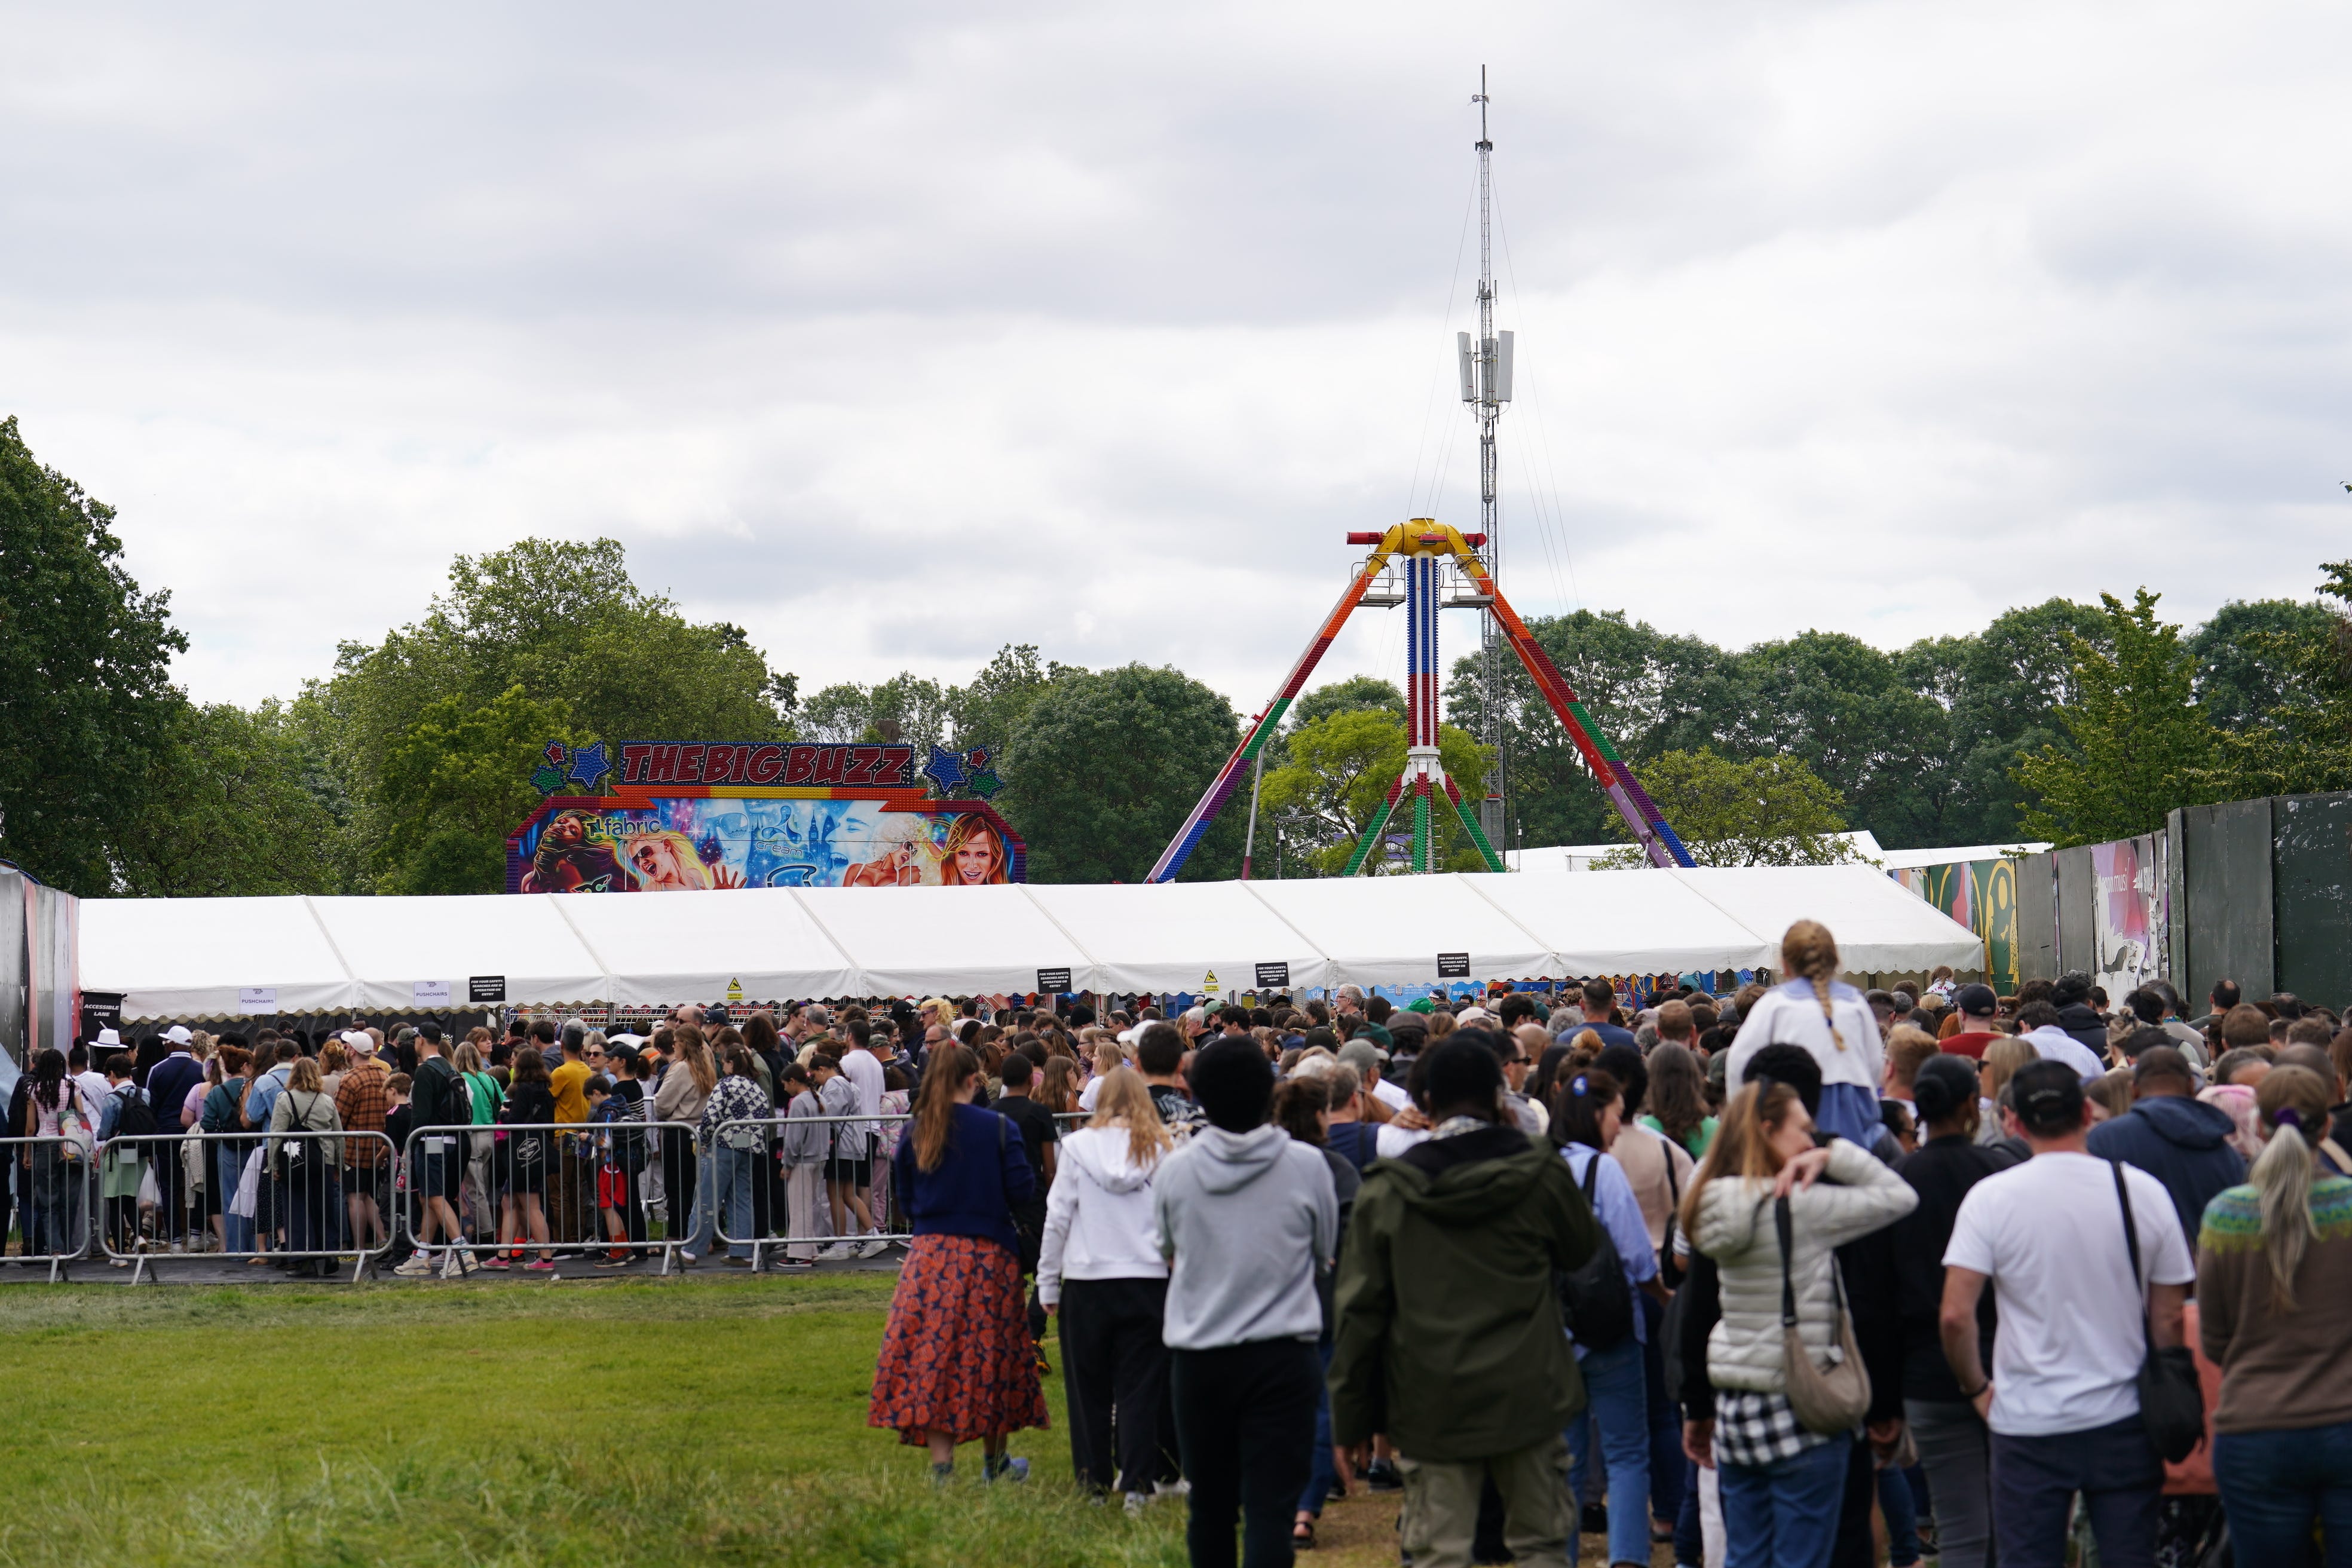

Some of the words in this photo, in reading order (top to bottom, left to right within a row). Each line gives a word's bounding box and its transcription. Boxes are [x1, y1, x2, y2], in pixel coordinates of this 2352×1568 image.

[605, 816, 660, 835] fabric
[756, 841, 803, 856] cream
[519, 1141, 537, 1153] VOLANO
